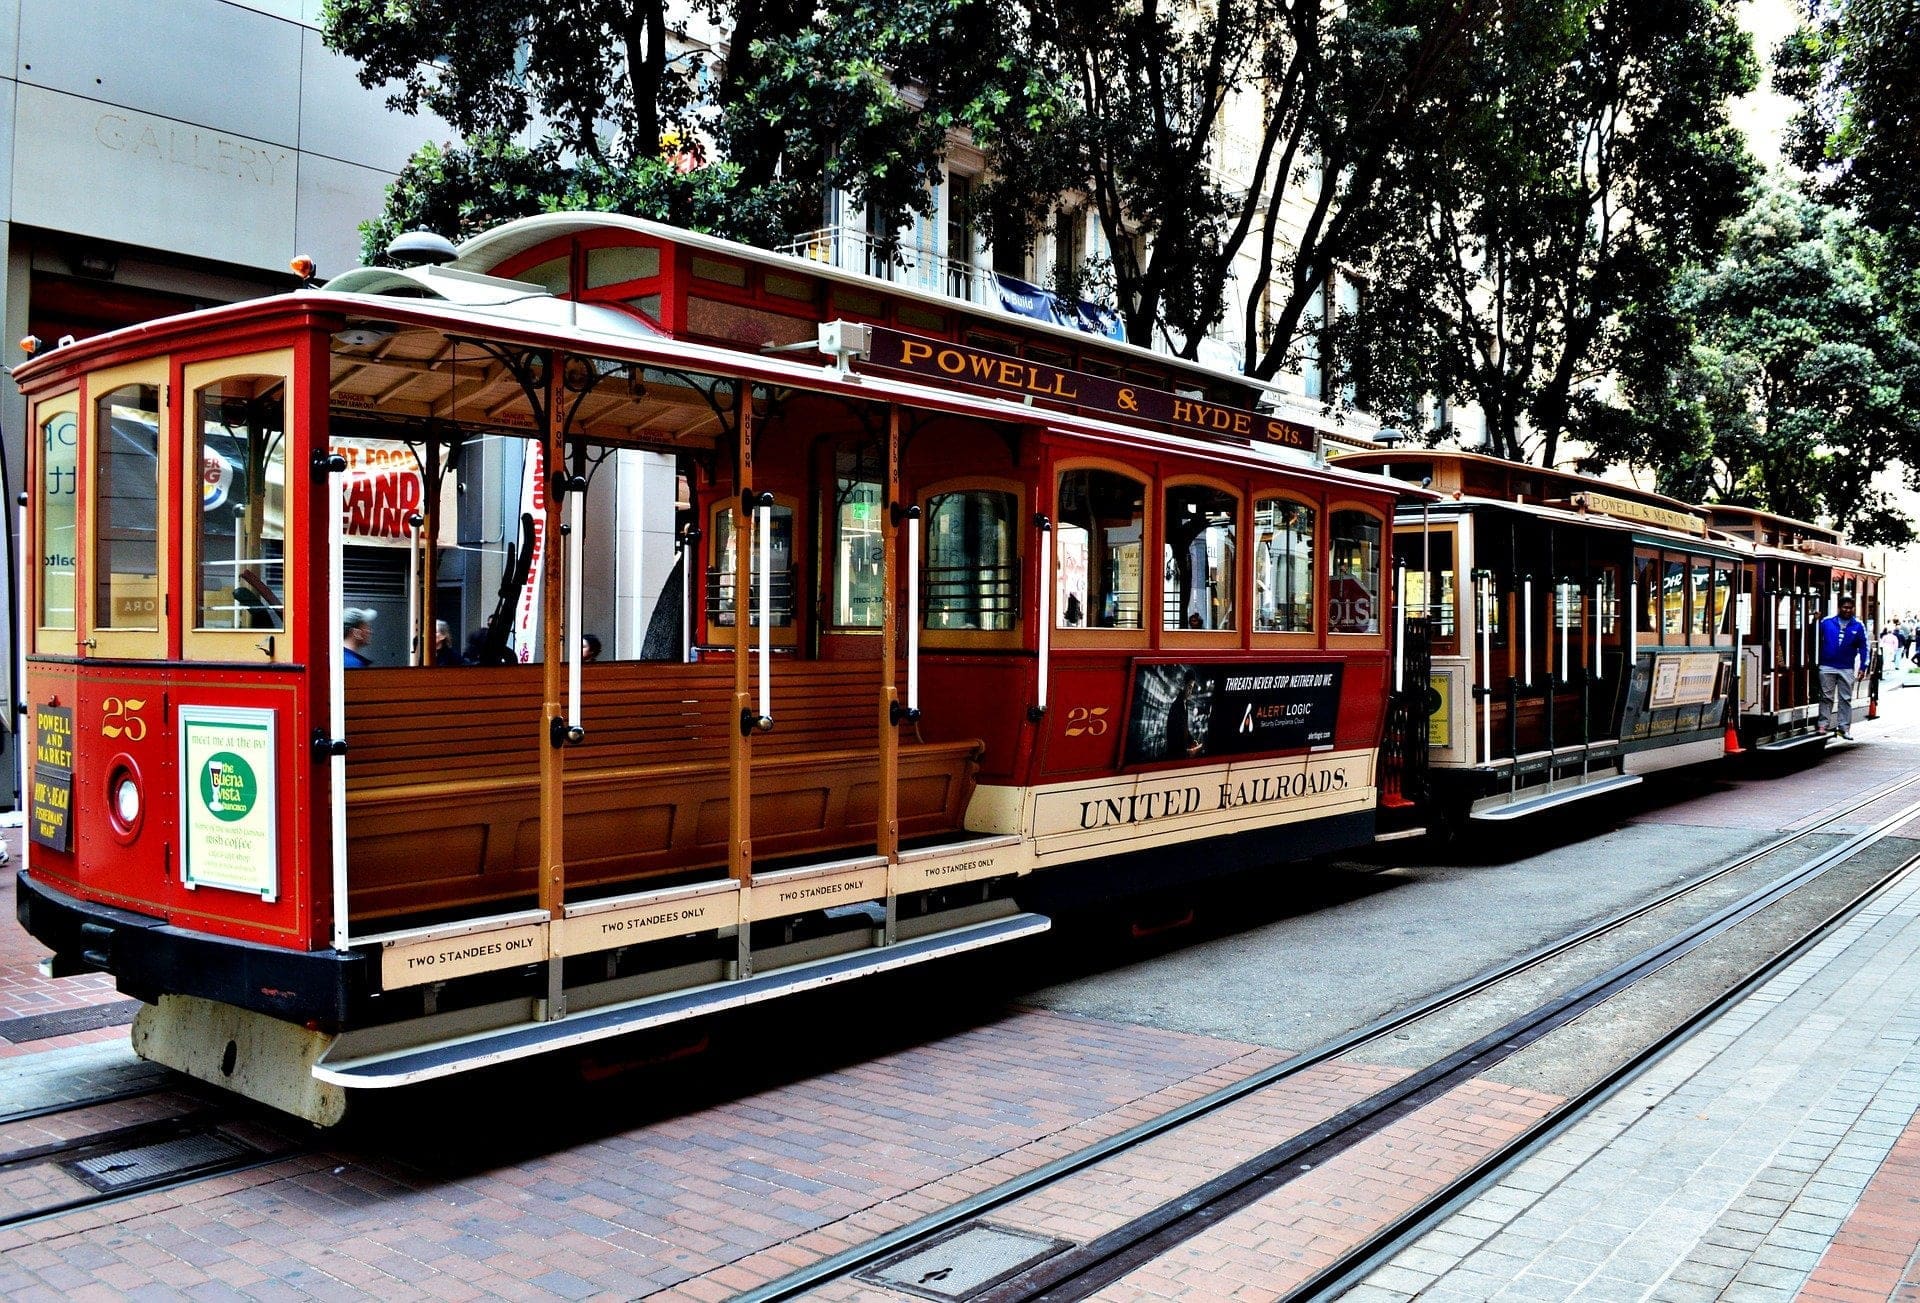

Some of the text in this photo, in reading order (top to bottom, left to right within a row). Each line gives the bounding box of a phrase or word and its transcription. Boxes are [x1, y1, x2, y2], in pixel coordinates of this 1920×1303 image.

[95, 114, 285, 186] GALLERY
[555, 387, 563, 423] HOLD
[901, 340, 1303, 446] POWELL & HYDE Sts.
[745, 452, 751, 468] ON
[1592, 496, 1639, 516] POWELL
[1654, 510, 1687, 527] MASON
[1225, 673, 1333, 691] THREATS NEVER STOP NEITHER DO WE
[38, 713, 71, 735] POWELL
[102, 697, 146, 741] 25
[1065, 706, 1110, 737] 25
[1256, 703, 1311, 718] ALERT LOGIC
[46, 735, 63, 747] AND
[38, 746, 72, 769] MARKET
[1080, 767, 1348, 830] UNITED RAILROADS.
[925, 858, 995, 877] TWO STANDEES ONLY
[779, 880, 864, 902] TWO STANDEES ONLY
[601, 907, 706, 934] TWO STANDEES ONLY
[407, 937, 534, 969] TWO STANDEES ONLY
